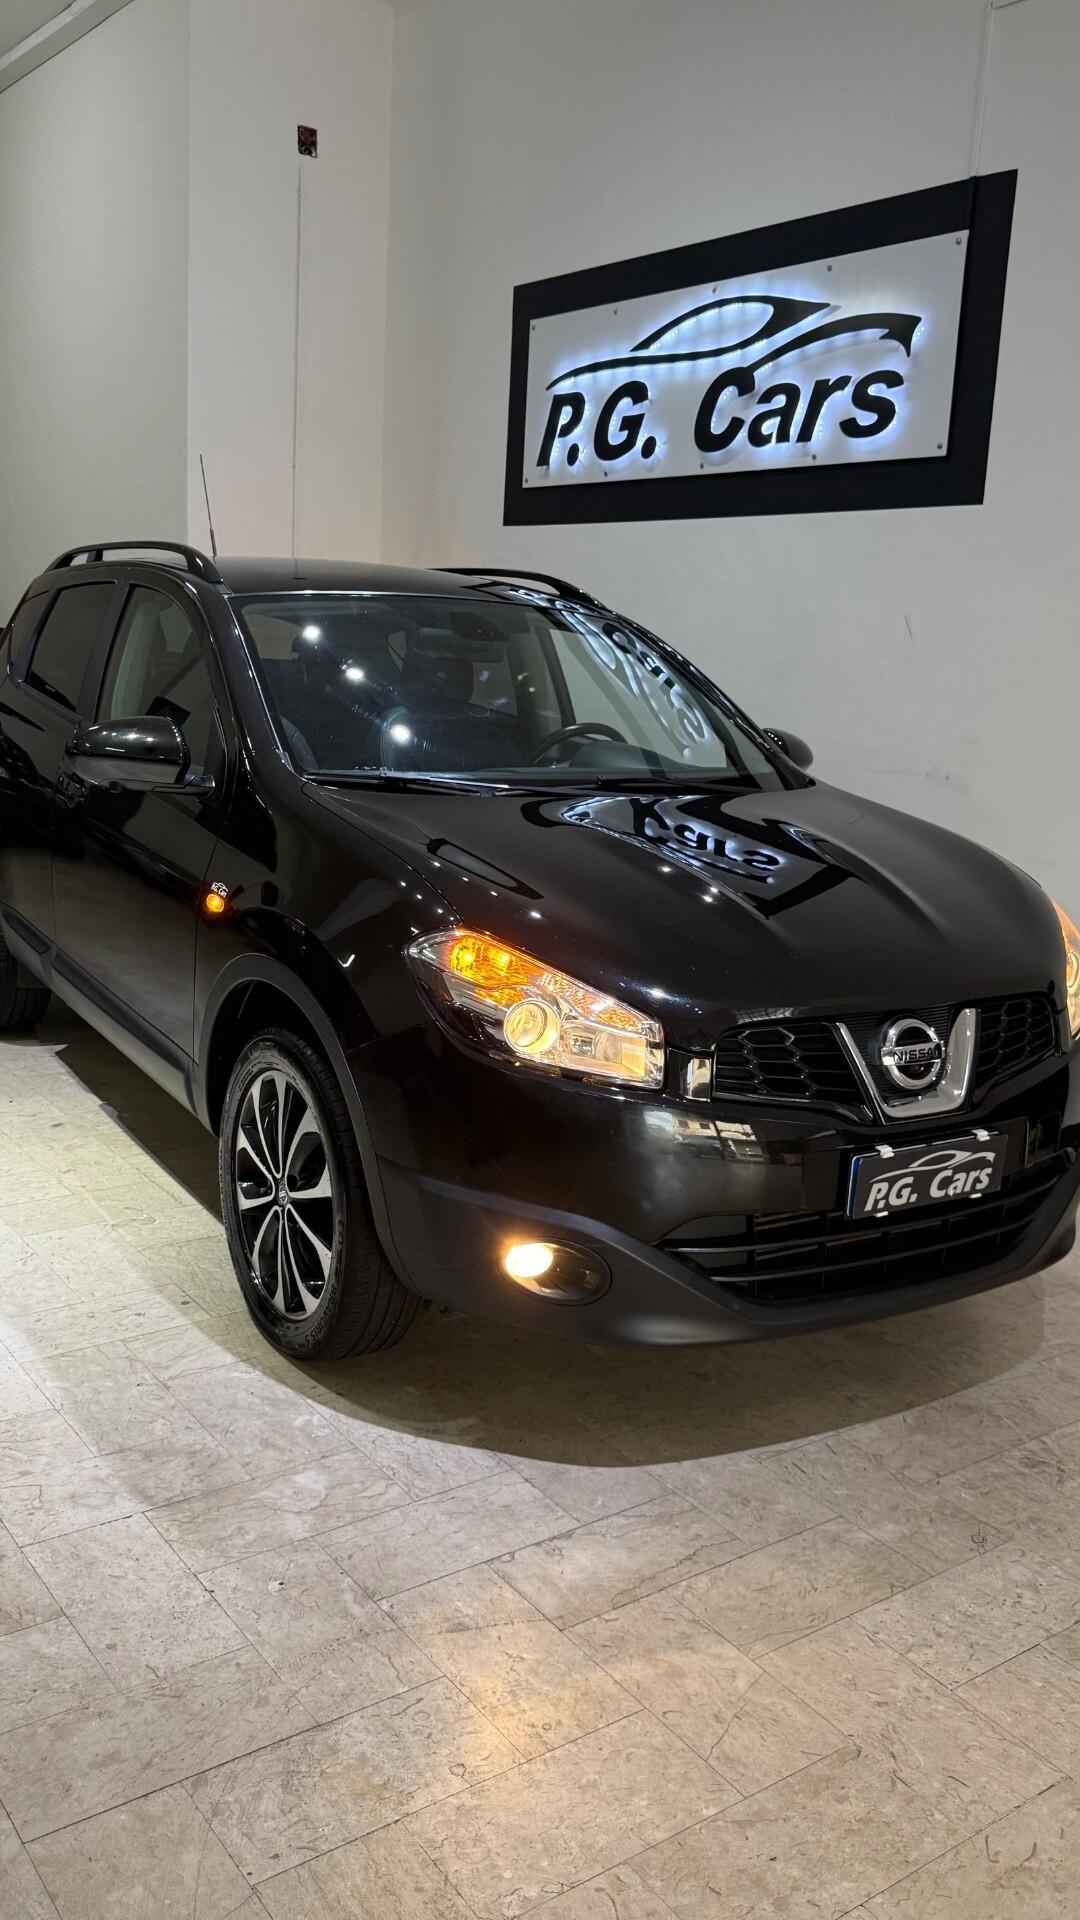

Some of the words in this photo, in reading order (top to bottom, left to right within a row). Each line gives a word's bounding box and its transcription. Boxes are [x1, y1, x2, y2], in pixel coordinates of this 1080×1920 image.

[536, 381, 657, 467] P.G.
[694, 366, 905, 453] Cars
[894, 1045, 941, 1063] NISSAN
[864, 1177, 918, 1212] P.G.
[929, 1168, 992, 1198] Cars
